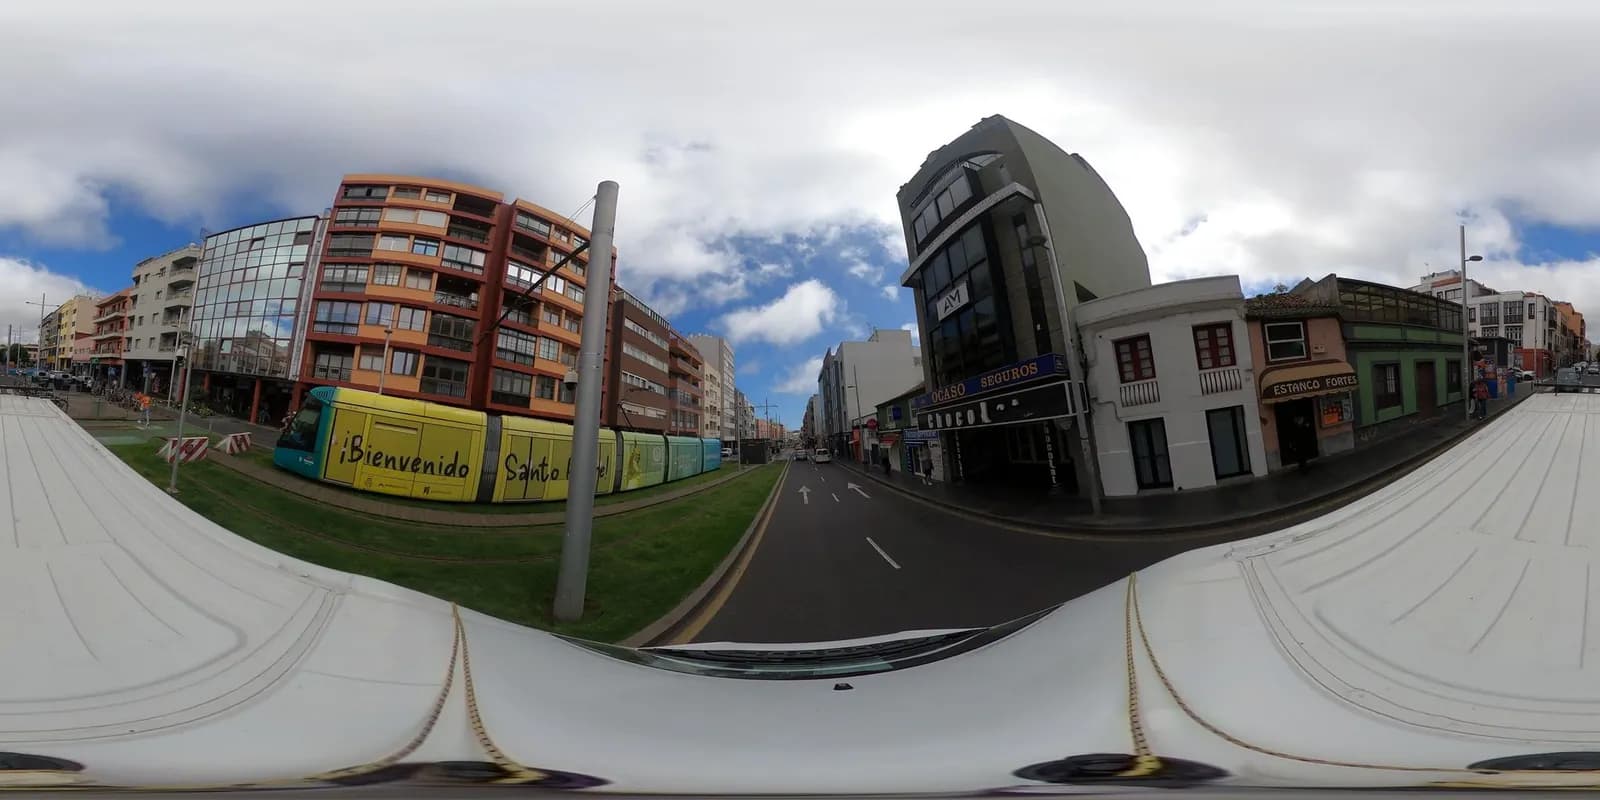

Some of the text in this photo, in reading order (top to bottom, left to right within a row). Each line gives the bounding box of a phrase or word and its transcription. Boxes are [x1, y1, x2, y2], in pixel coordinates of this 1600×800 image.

[931, 361, 1039, 403] OCASO SEGUROS
[1273, 375, 1358, 396] ESTANCO FORTES
[339, 430, 469, 478] ¡Bienvenido
[505, 453, 560, 482] Santo
